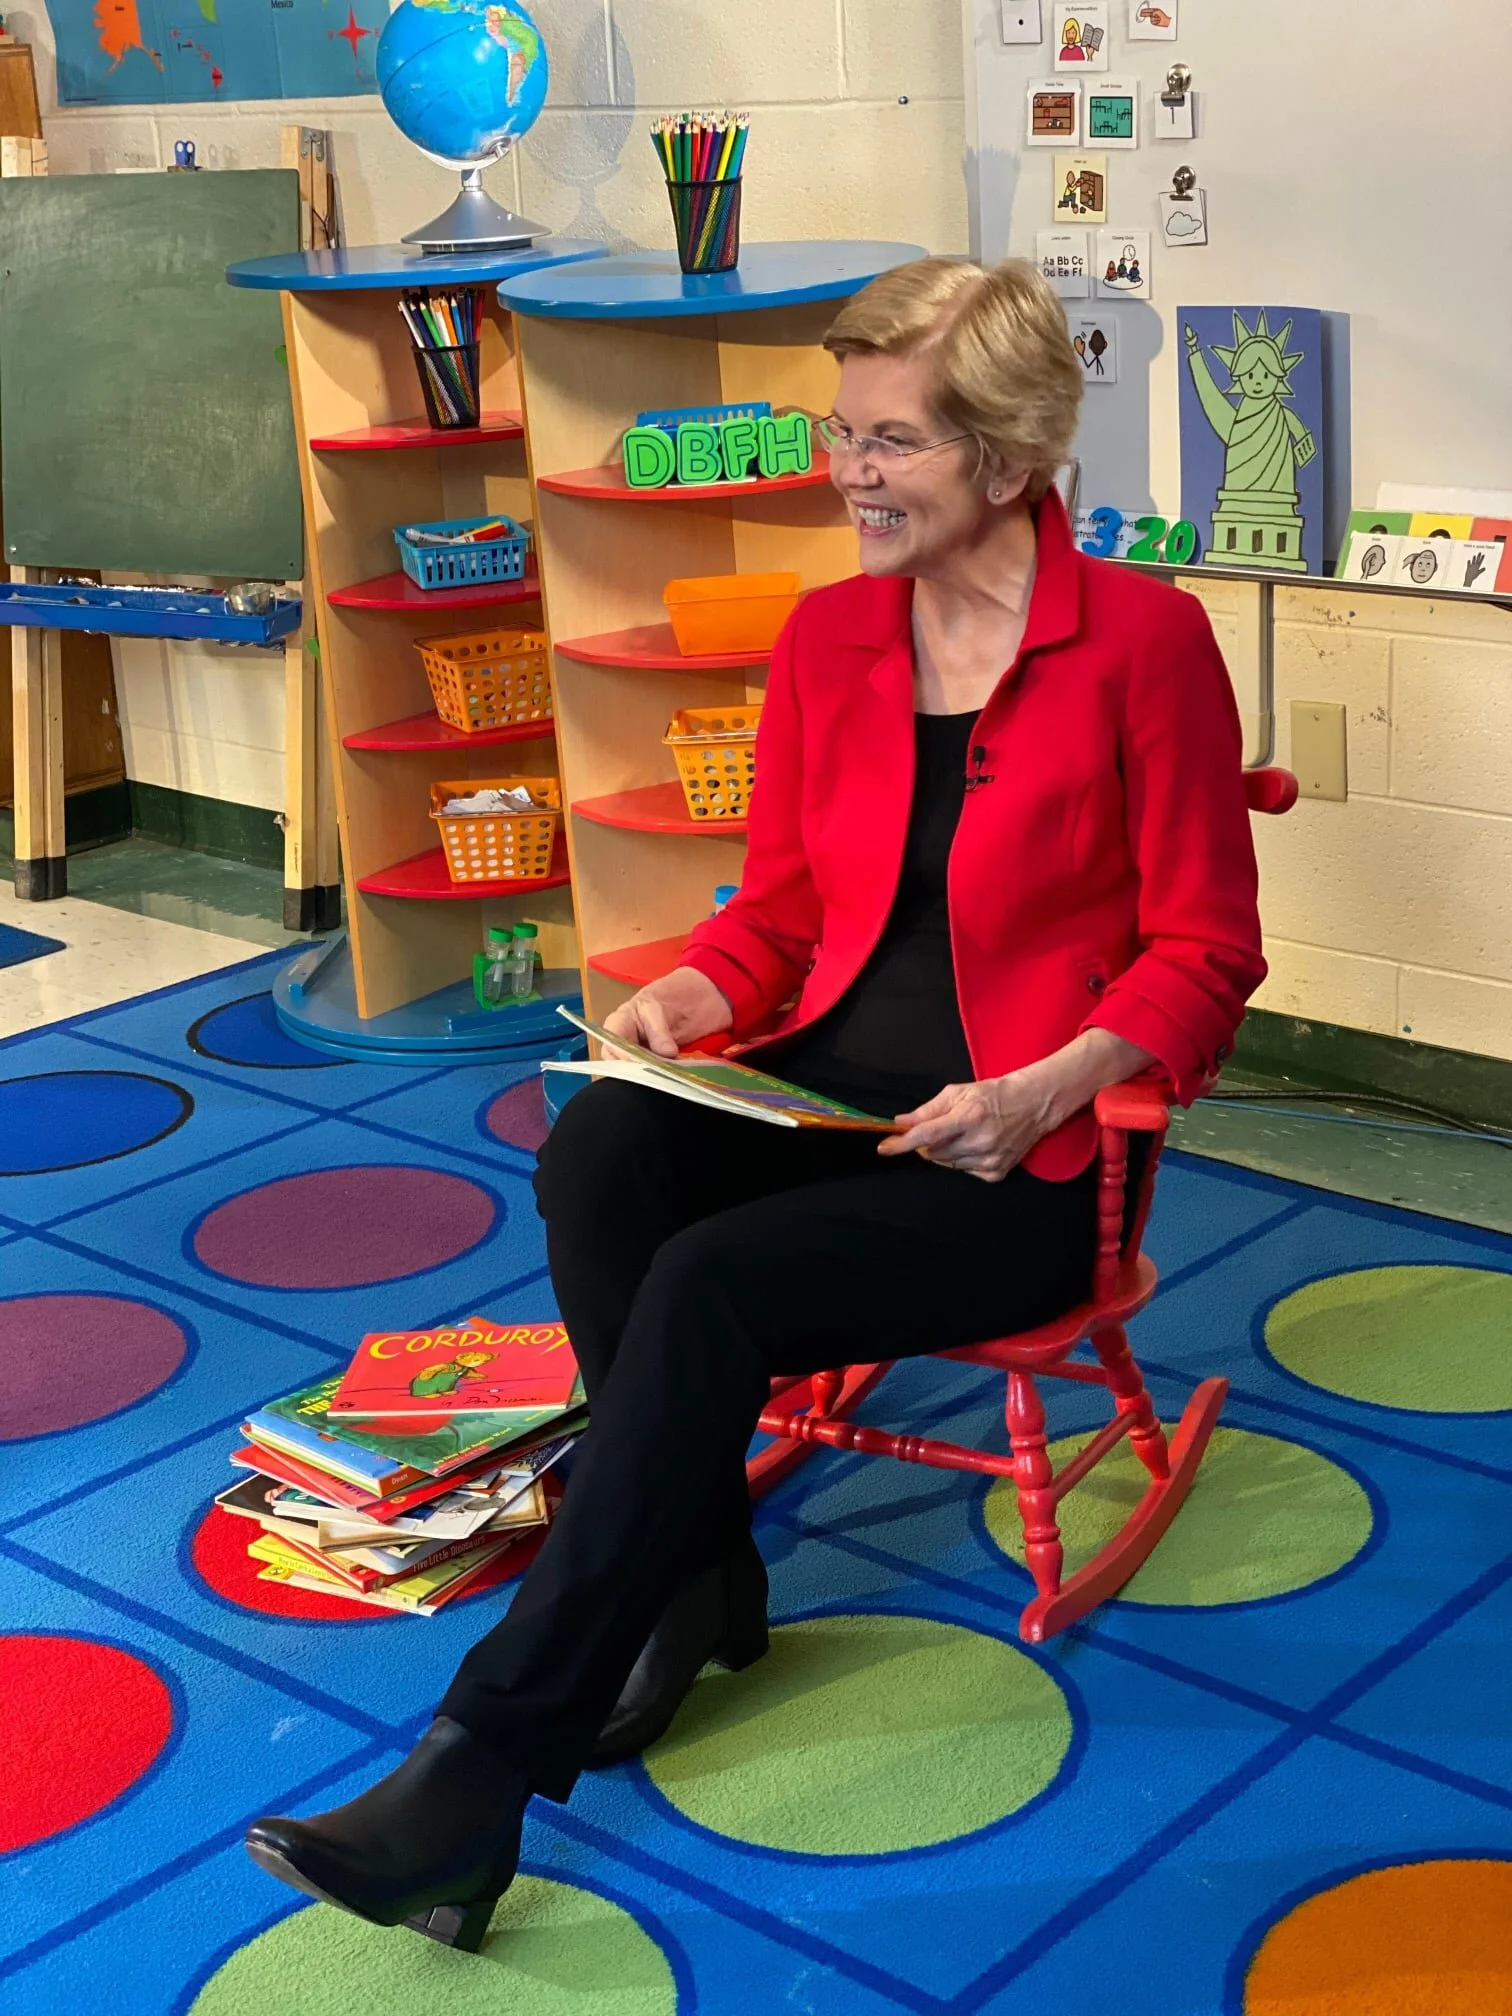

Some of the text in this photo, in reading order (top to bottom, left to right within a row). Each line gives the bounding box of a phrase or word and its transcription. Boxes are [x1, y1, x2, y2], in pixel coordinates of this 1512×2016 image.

[271, 0, 294, 9] Mexico
[1043, 256, 1083, 266] Aa Bb Cc
[1043, 267, 1082, 277] Dd Ee Ff
[429, 1550, 449, 1565] Little
